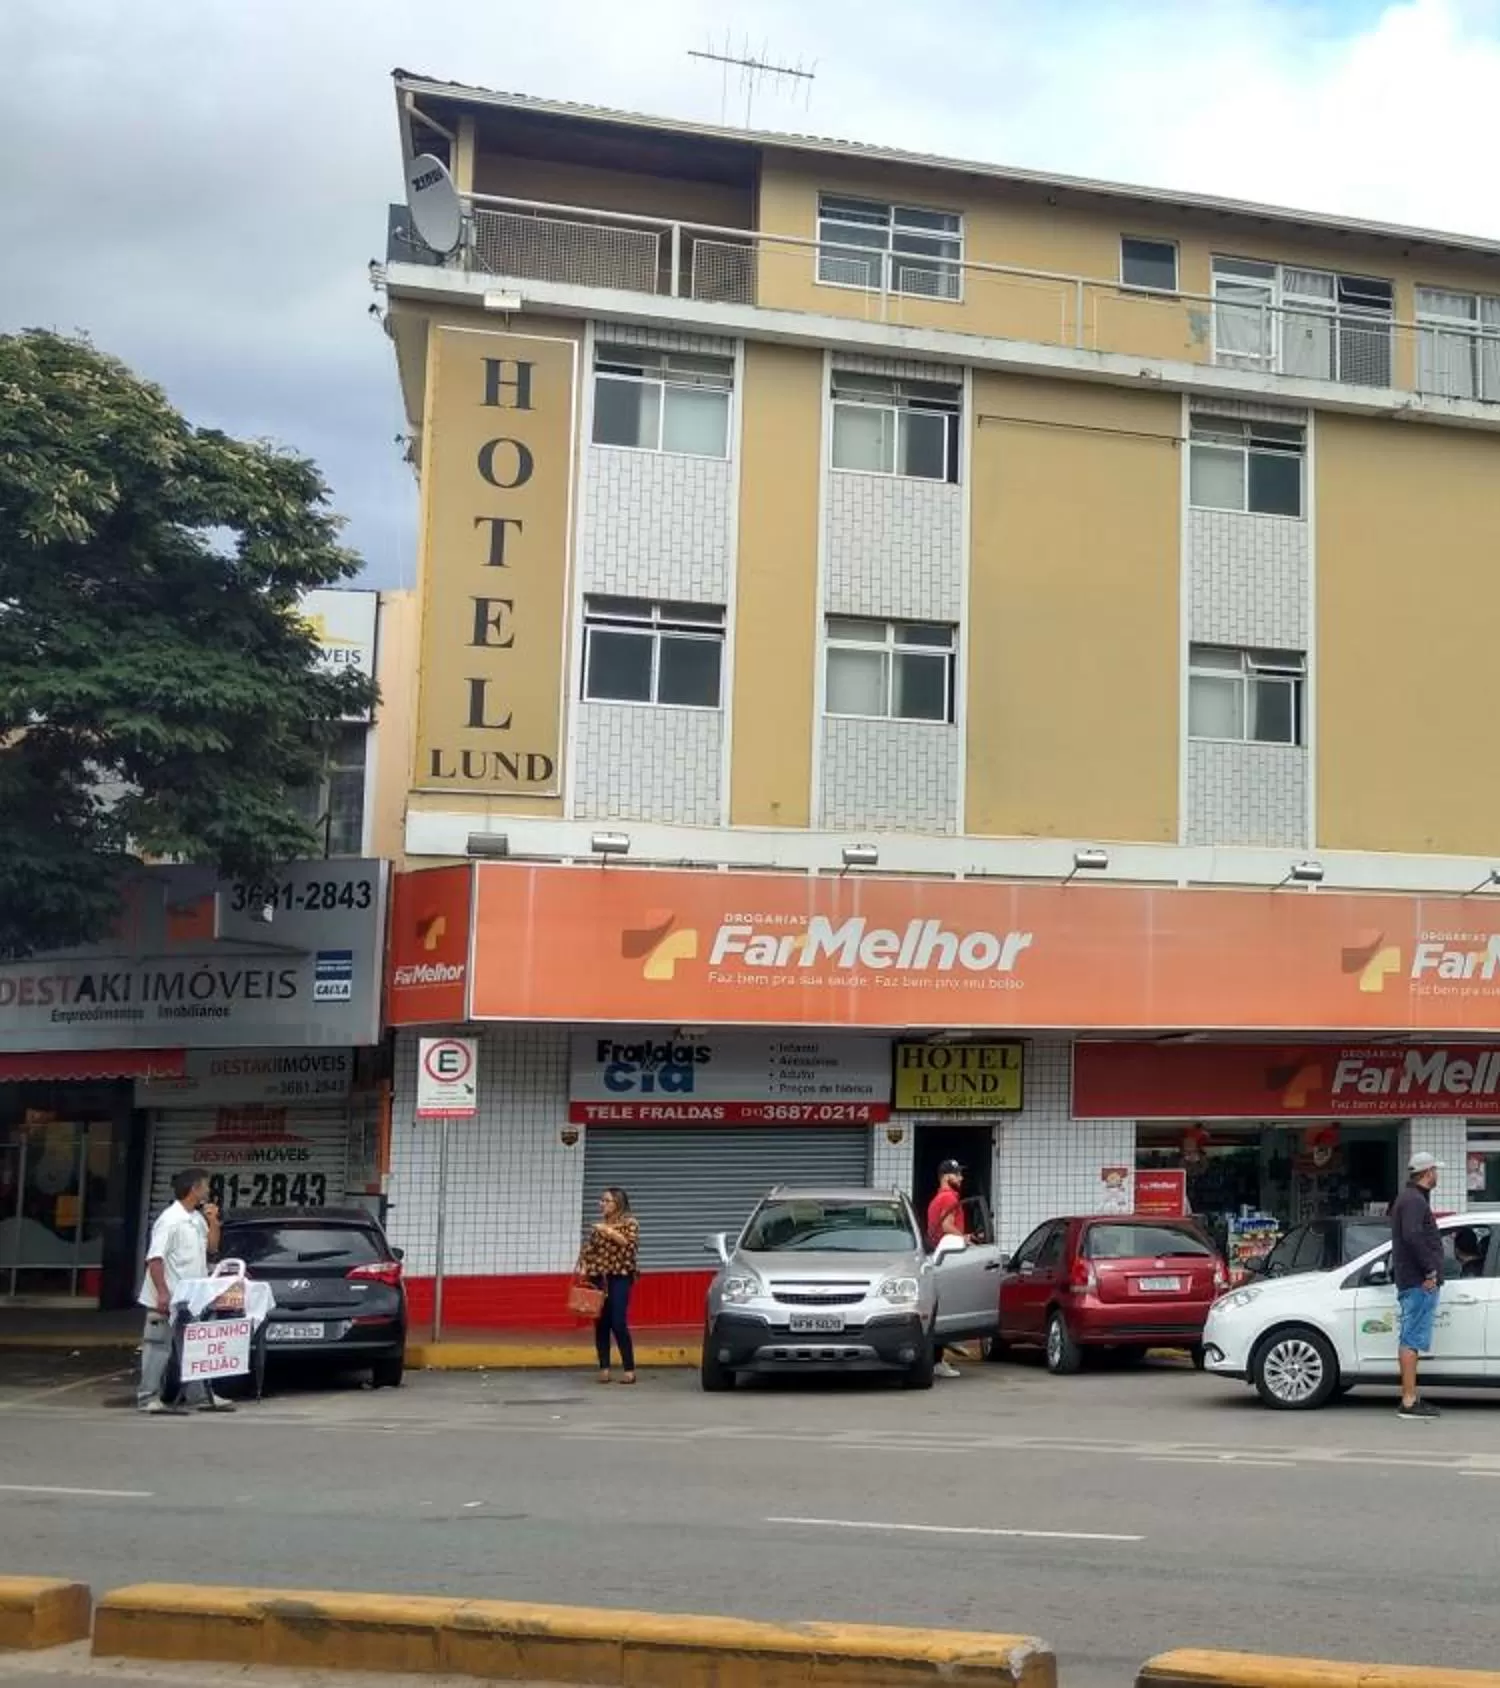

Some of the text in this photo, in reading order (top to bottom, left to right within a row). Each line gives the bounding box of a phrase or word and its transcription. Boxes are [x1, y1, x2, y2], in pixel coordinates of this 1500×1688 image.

[464, 356, 537, 731] HOTEL
[313, 648, 361, 664] VEIS
[430, 748, 553, 782] LUND
[724, 913, 808, 925] DROGARIAS
[709, 915, 1033, 972] FarMelhor
[142, 964, 298, 1002] IMÓVEIS
[708, 971, 733, 983] Faz
[875, 975, 899, 987] Faz
[316, 984, 349, 995] CAIXA
[438, 1050, 459, 1073] E
[596, 1039, 712, 1064] Fraldas
[903, 1046, 1019, 1069] HOTEL
[921, 1073, 999, 1093] LUND
[585, 1106, 633, 1120] TELE
[640, 1106, 725, 1120] FRALDAS
[763, 1105, 870, 1120] 3687.0214
[186, 1323, 249, 1342] BOLINHO
[207, 1342, 225, 1356] DE
